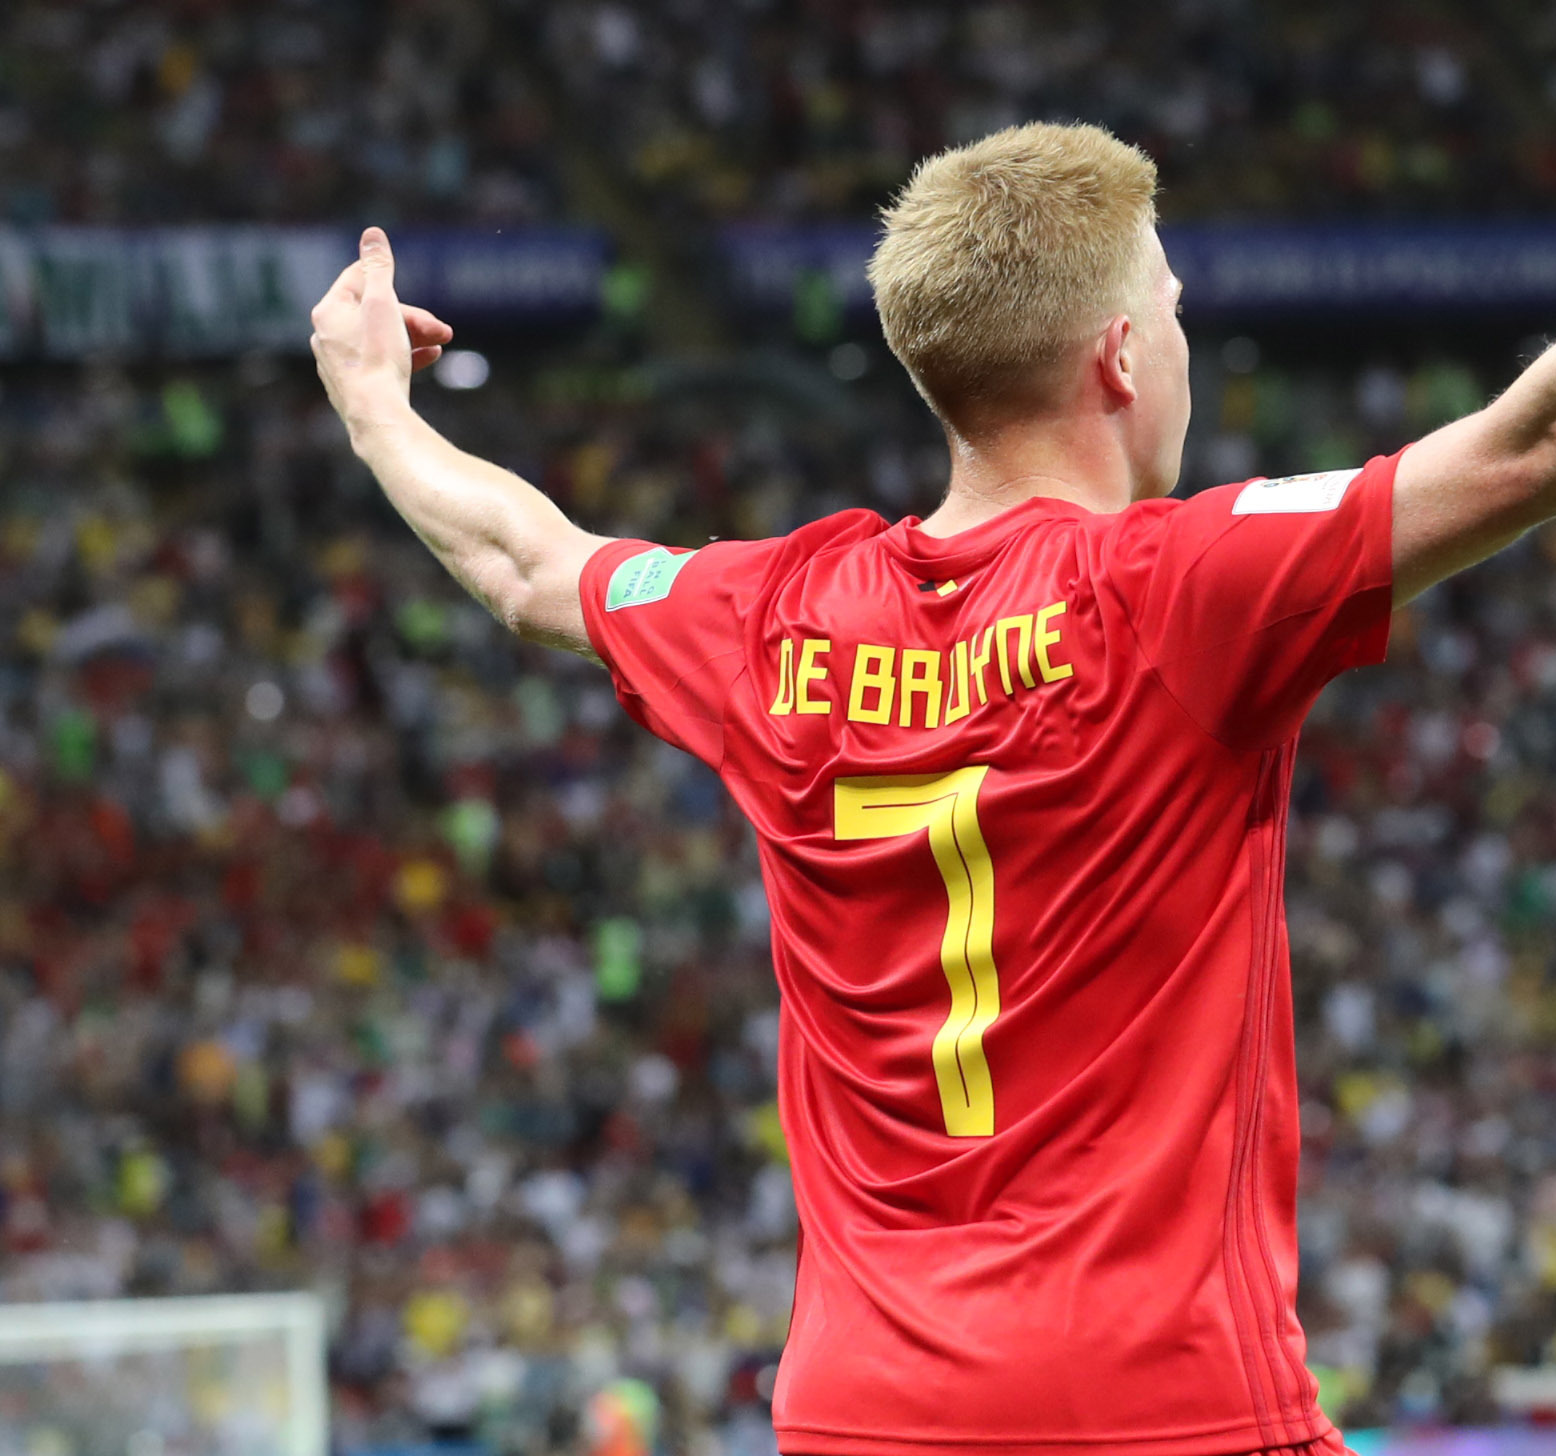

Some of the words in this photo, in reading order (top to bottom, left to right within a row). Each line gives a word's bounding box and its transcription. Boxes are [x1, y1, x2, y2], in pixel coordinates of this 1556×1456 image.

[769, 637, 831, 715] DE
[847, 600, 1074, 729] BRUYNE
[834, 765, 1001, 1137] 7
